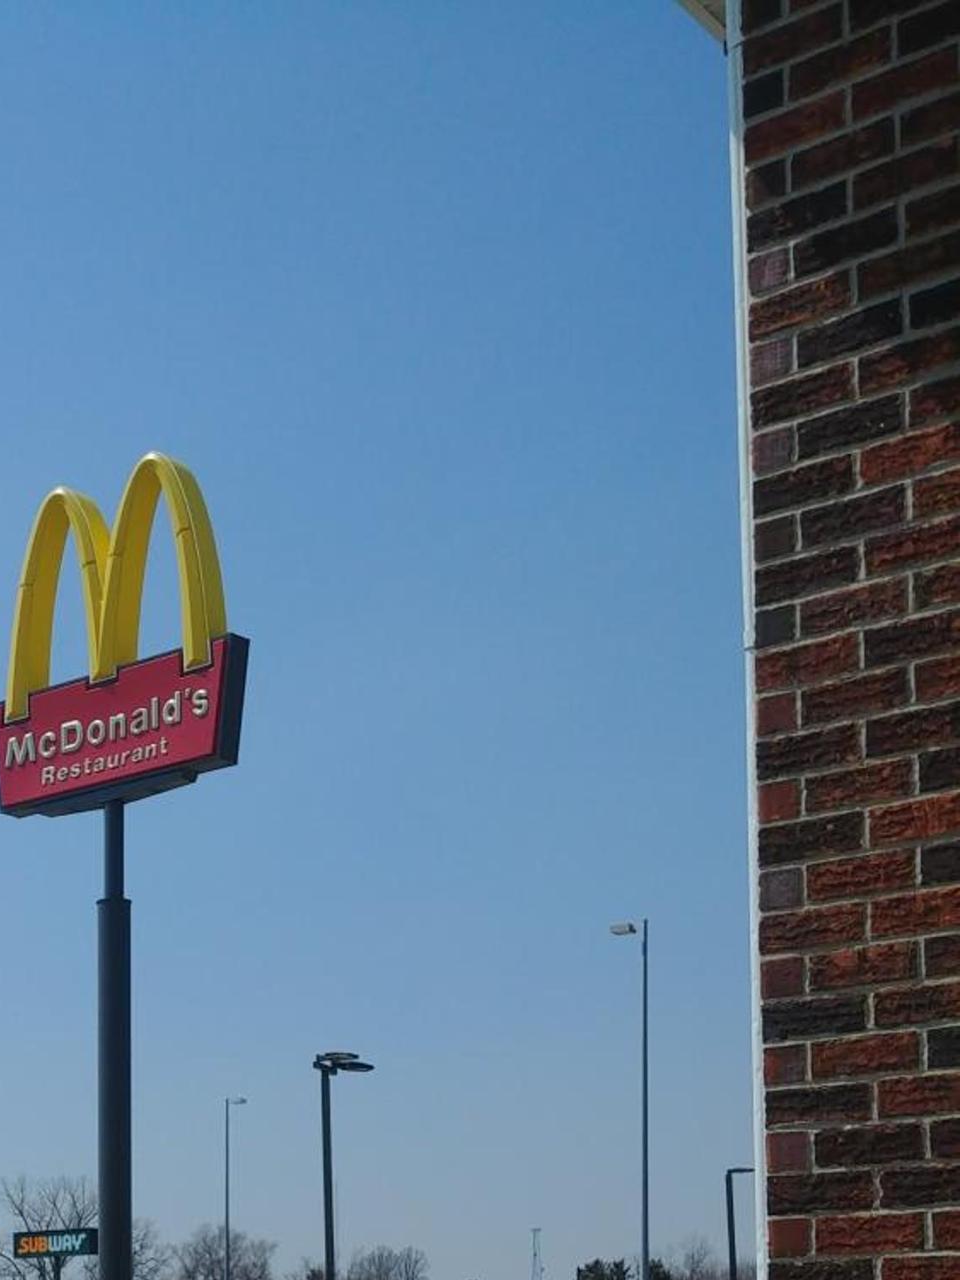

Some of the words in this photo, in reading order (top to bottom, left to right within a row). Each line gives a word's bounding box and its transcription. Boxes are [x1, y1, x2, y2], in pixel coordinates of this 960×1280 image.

[5, 687, 209, 768] McDonald's
[41, 736, 169, 786] Restaurant
[17, 1233, 86, 1254] SUBWAY
